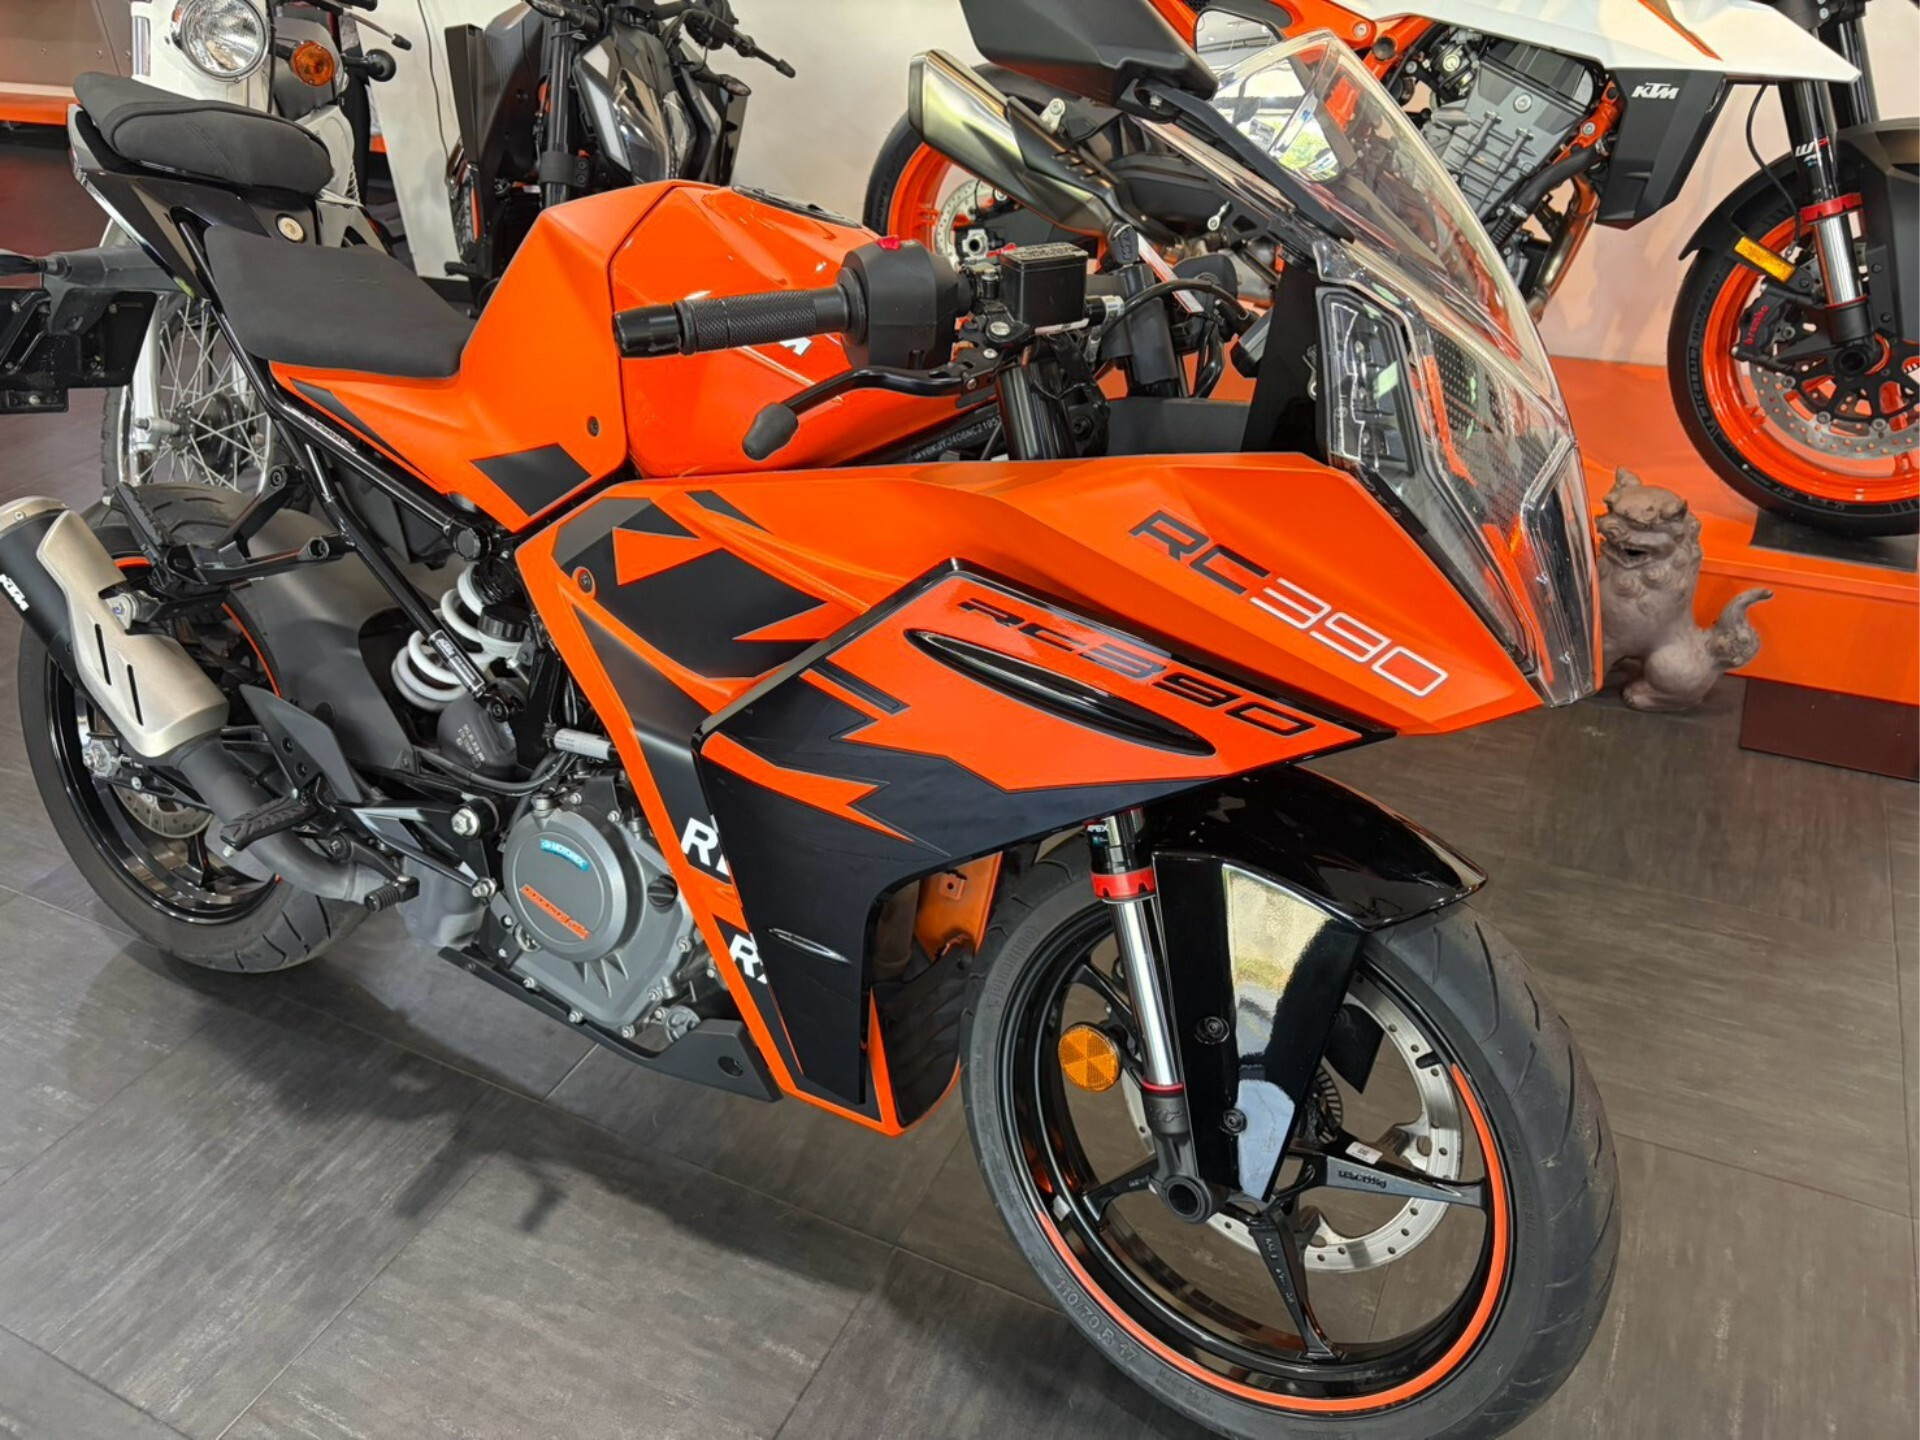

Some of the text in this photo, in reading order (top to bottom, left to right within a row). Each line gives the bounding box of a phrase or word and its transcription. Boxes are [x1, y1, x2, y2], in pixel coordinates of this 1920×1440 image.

[1631, 82, 1680, 100] KTM
[1745, 305, 1769, 346] brembo
[0, 573, 30, 611] KTM
[1127, 509, 1448, 698] RC390
[956, 597, 1317, 737] RC390
